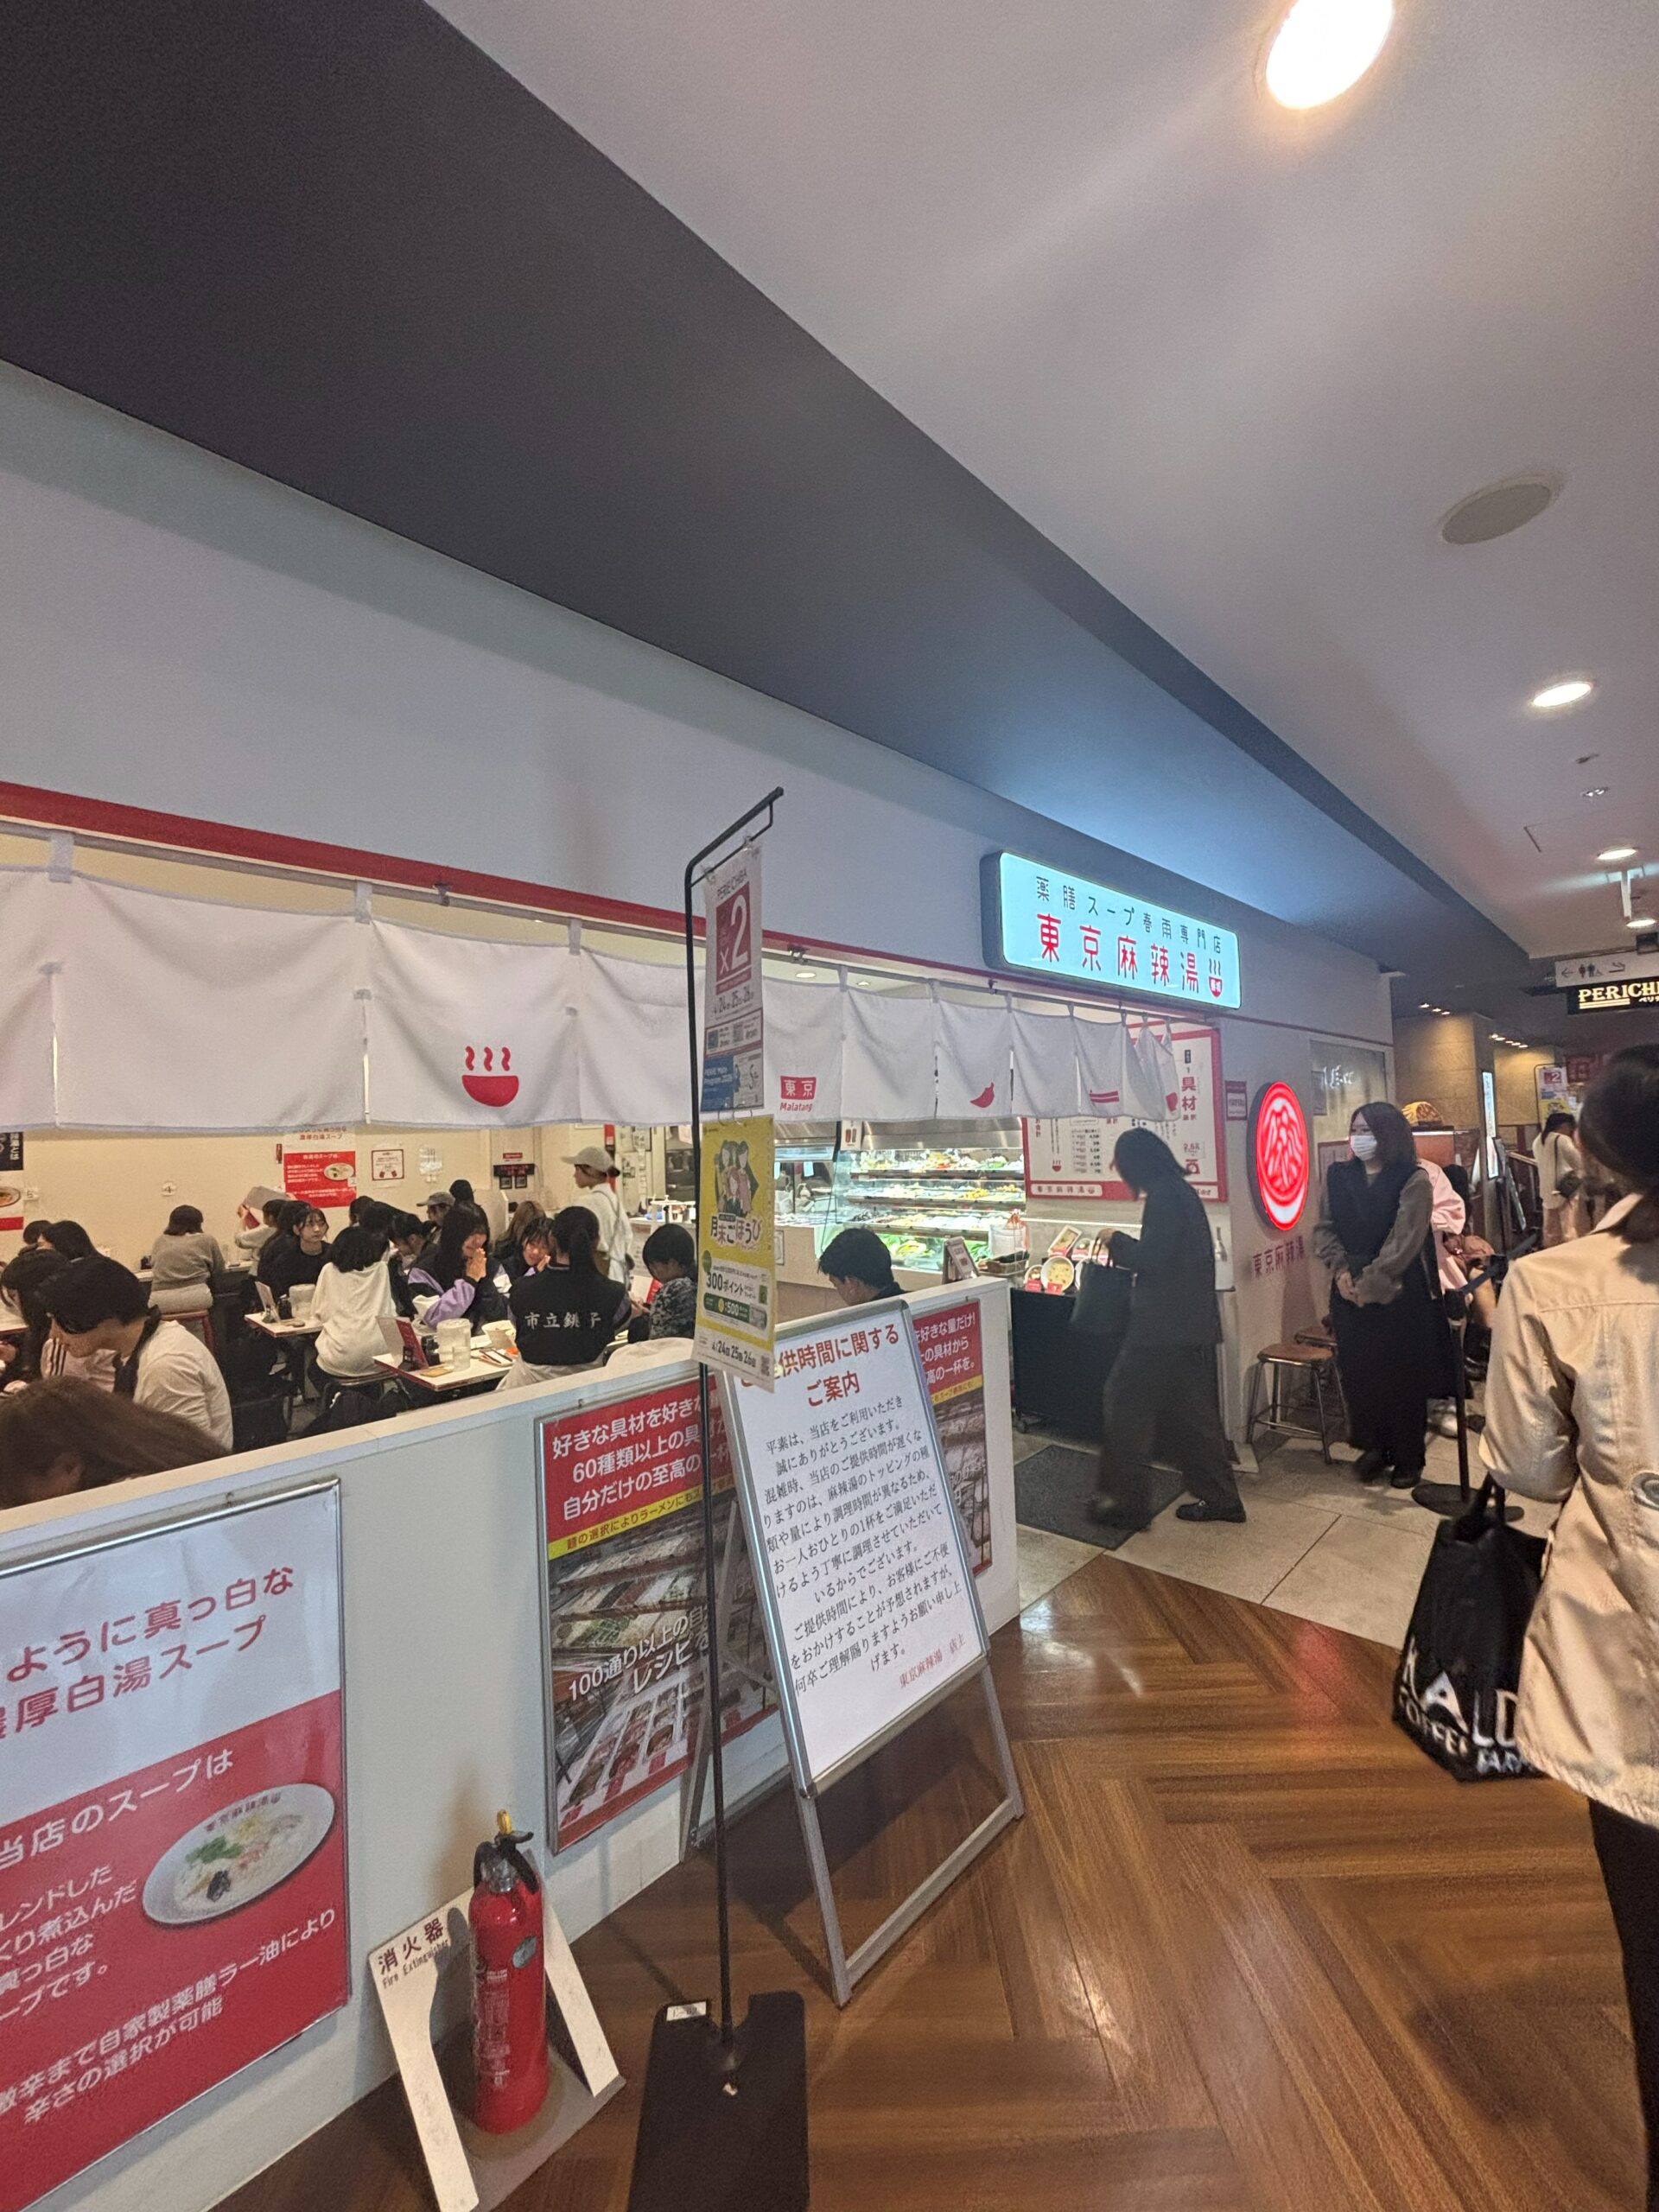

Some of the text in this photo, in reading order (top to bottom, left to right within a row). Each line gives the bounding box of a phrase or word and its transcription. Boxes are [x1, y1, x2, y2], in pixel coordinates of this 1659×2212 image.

[1037, 913, 1199, 994] 東京麻辣湯
[1578, 981, 1659, 1002] PERICH
[780, 1101, 813, 1113] Malatang
[785, 1080, 813, 1097] 東京
[774, 1323, 899, 1381] 供時間に関する
[806, 1370, 861, 1408] ご案内
[7, 1567, 294, 1682] ように真っ白な
[0, 1614, 267, 1740] 厚白湯スープ
[869, 1643, 906, 1673] げます。
[378, 1916, 444, 1976] 消火器
[382, 1938, 448, 1989] Fire Extinguisher
[23, 1995, 224, 2125] 辛さの選択が可能
